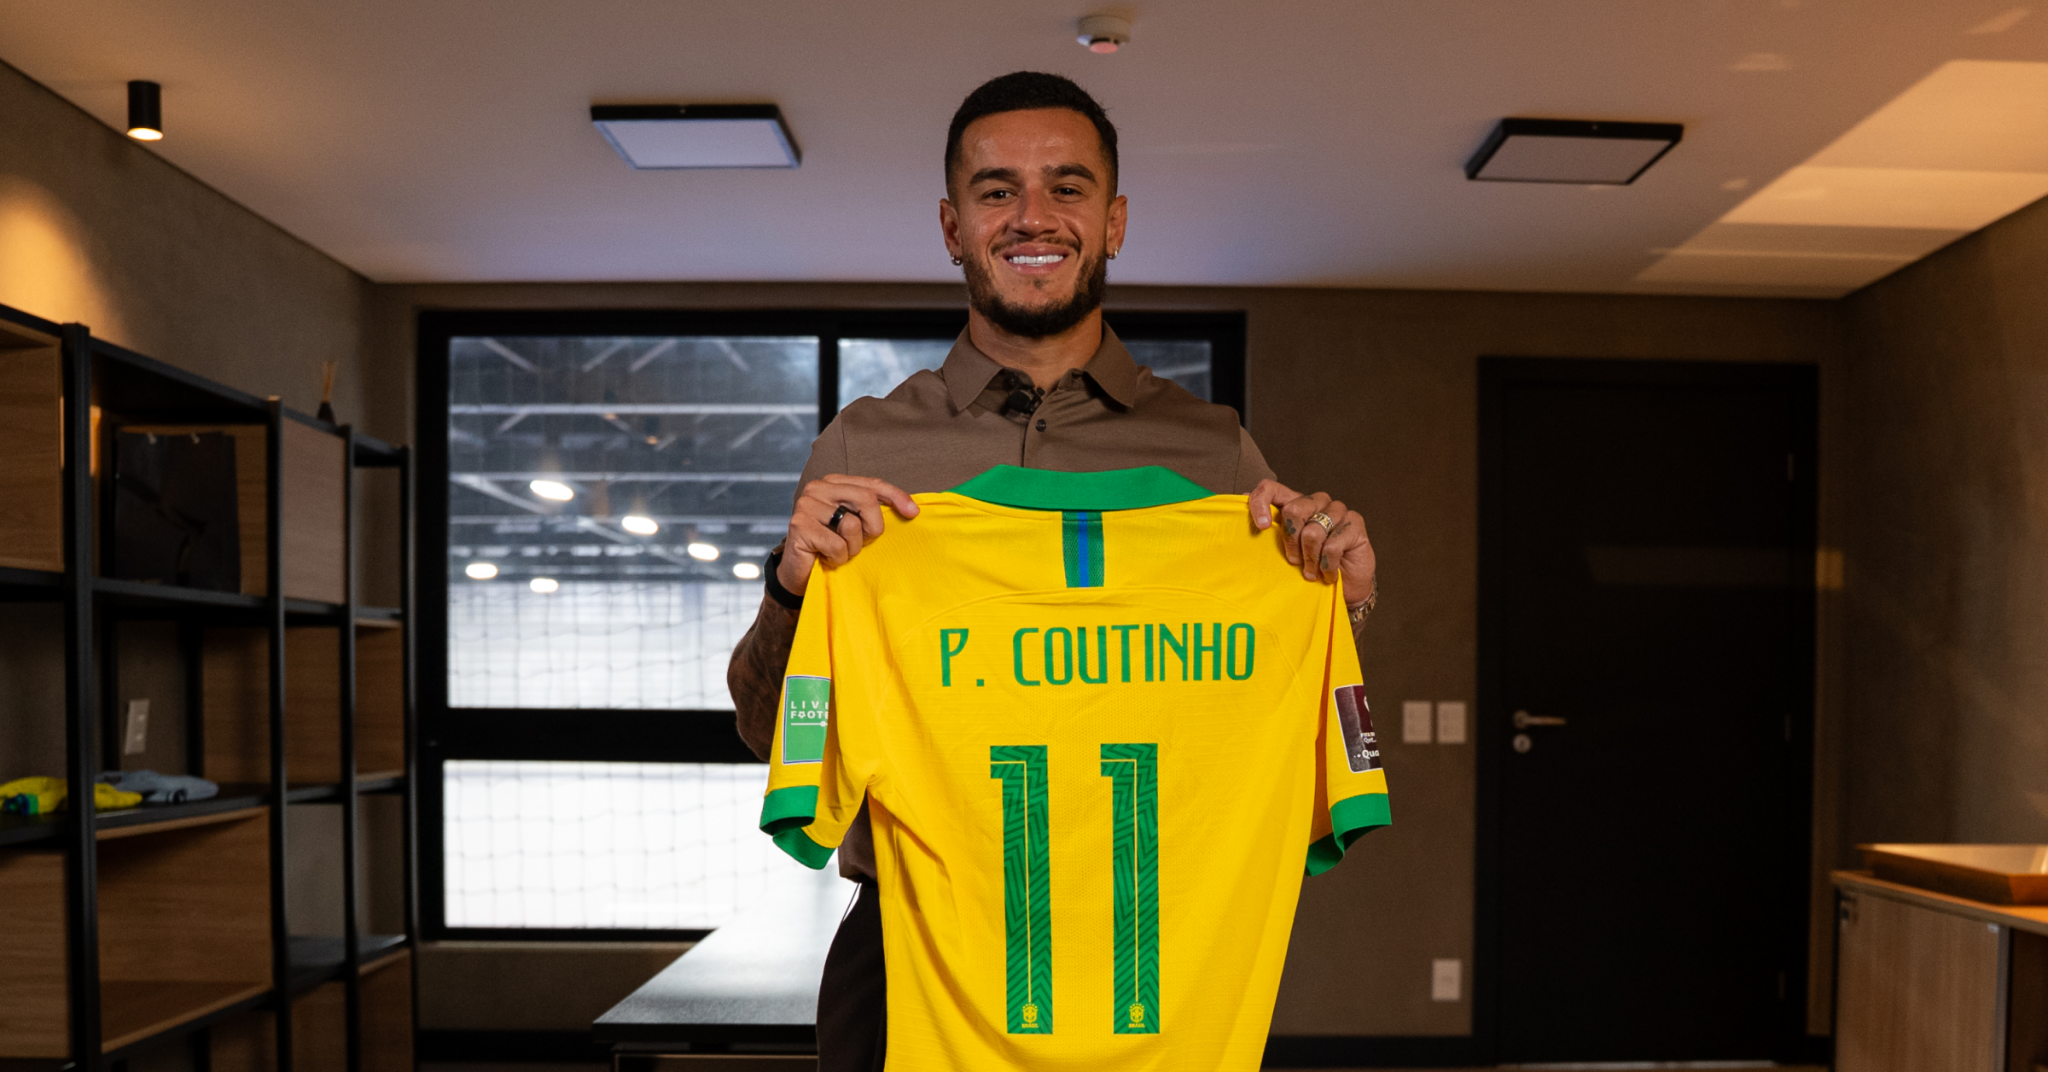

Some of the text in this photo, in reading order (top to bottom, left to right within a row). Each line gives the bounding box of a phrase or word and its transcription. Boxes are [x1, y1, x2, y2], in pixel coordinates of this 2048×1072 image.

[940, 622, 1256, 687] P. COUTINHO
[990, 743, 1160, 1034] 11
